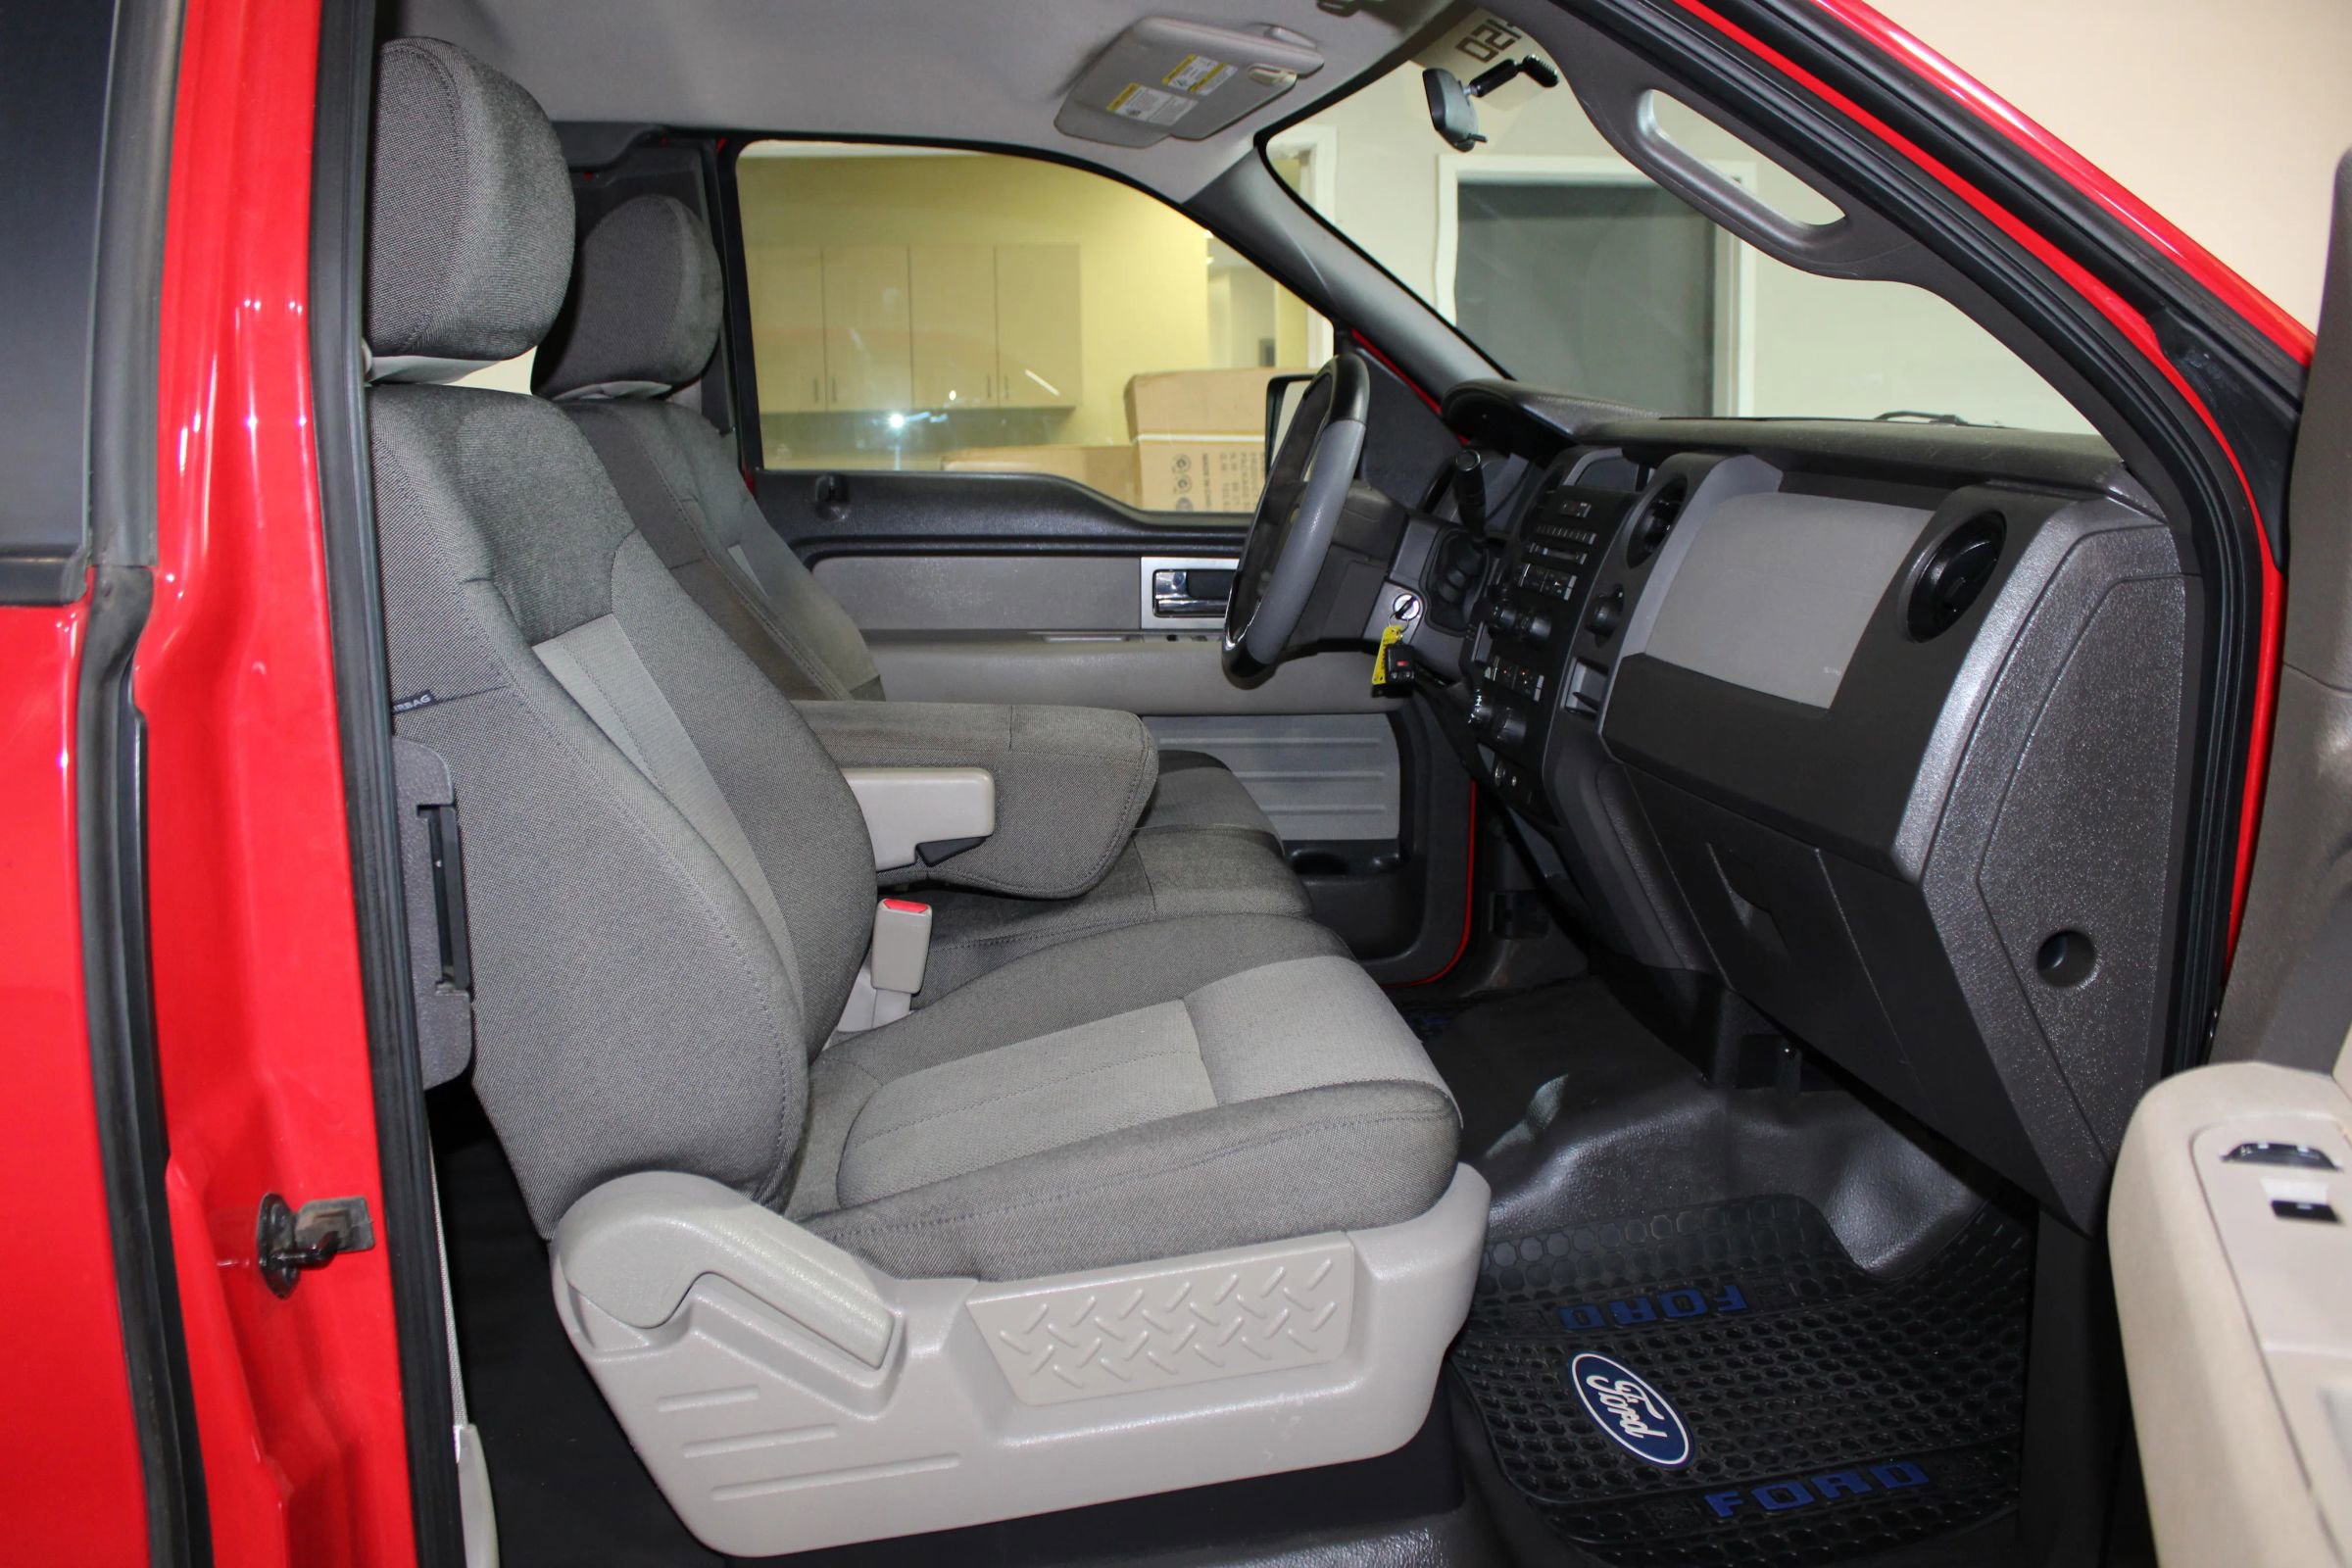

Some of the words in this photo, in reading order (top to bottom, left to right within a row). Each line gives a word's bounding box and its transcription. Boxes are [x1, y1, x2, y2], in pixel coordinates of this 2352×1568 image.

[393, 694, 431, 712] IRBAG
[1558, 1285, 1748, 1331] FORD
[1585, 1373, 1669, 1440] Ford
[1704, 1461, 1930, 1518] FORD
